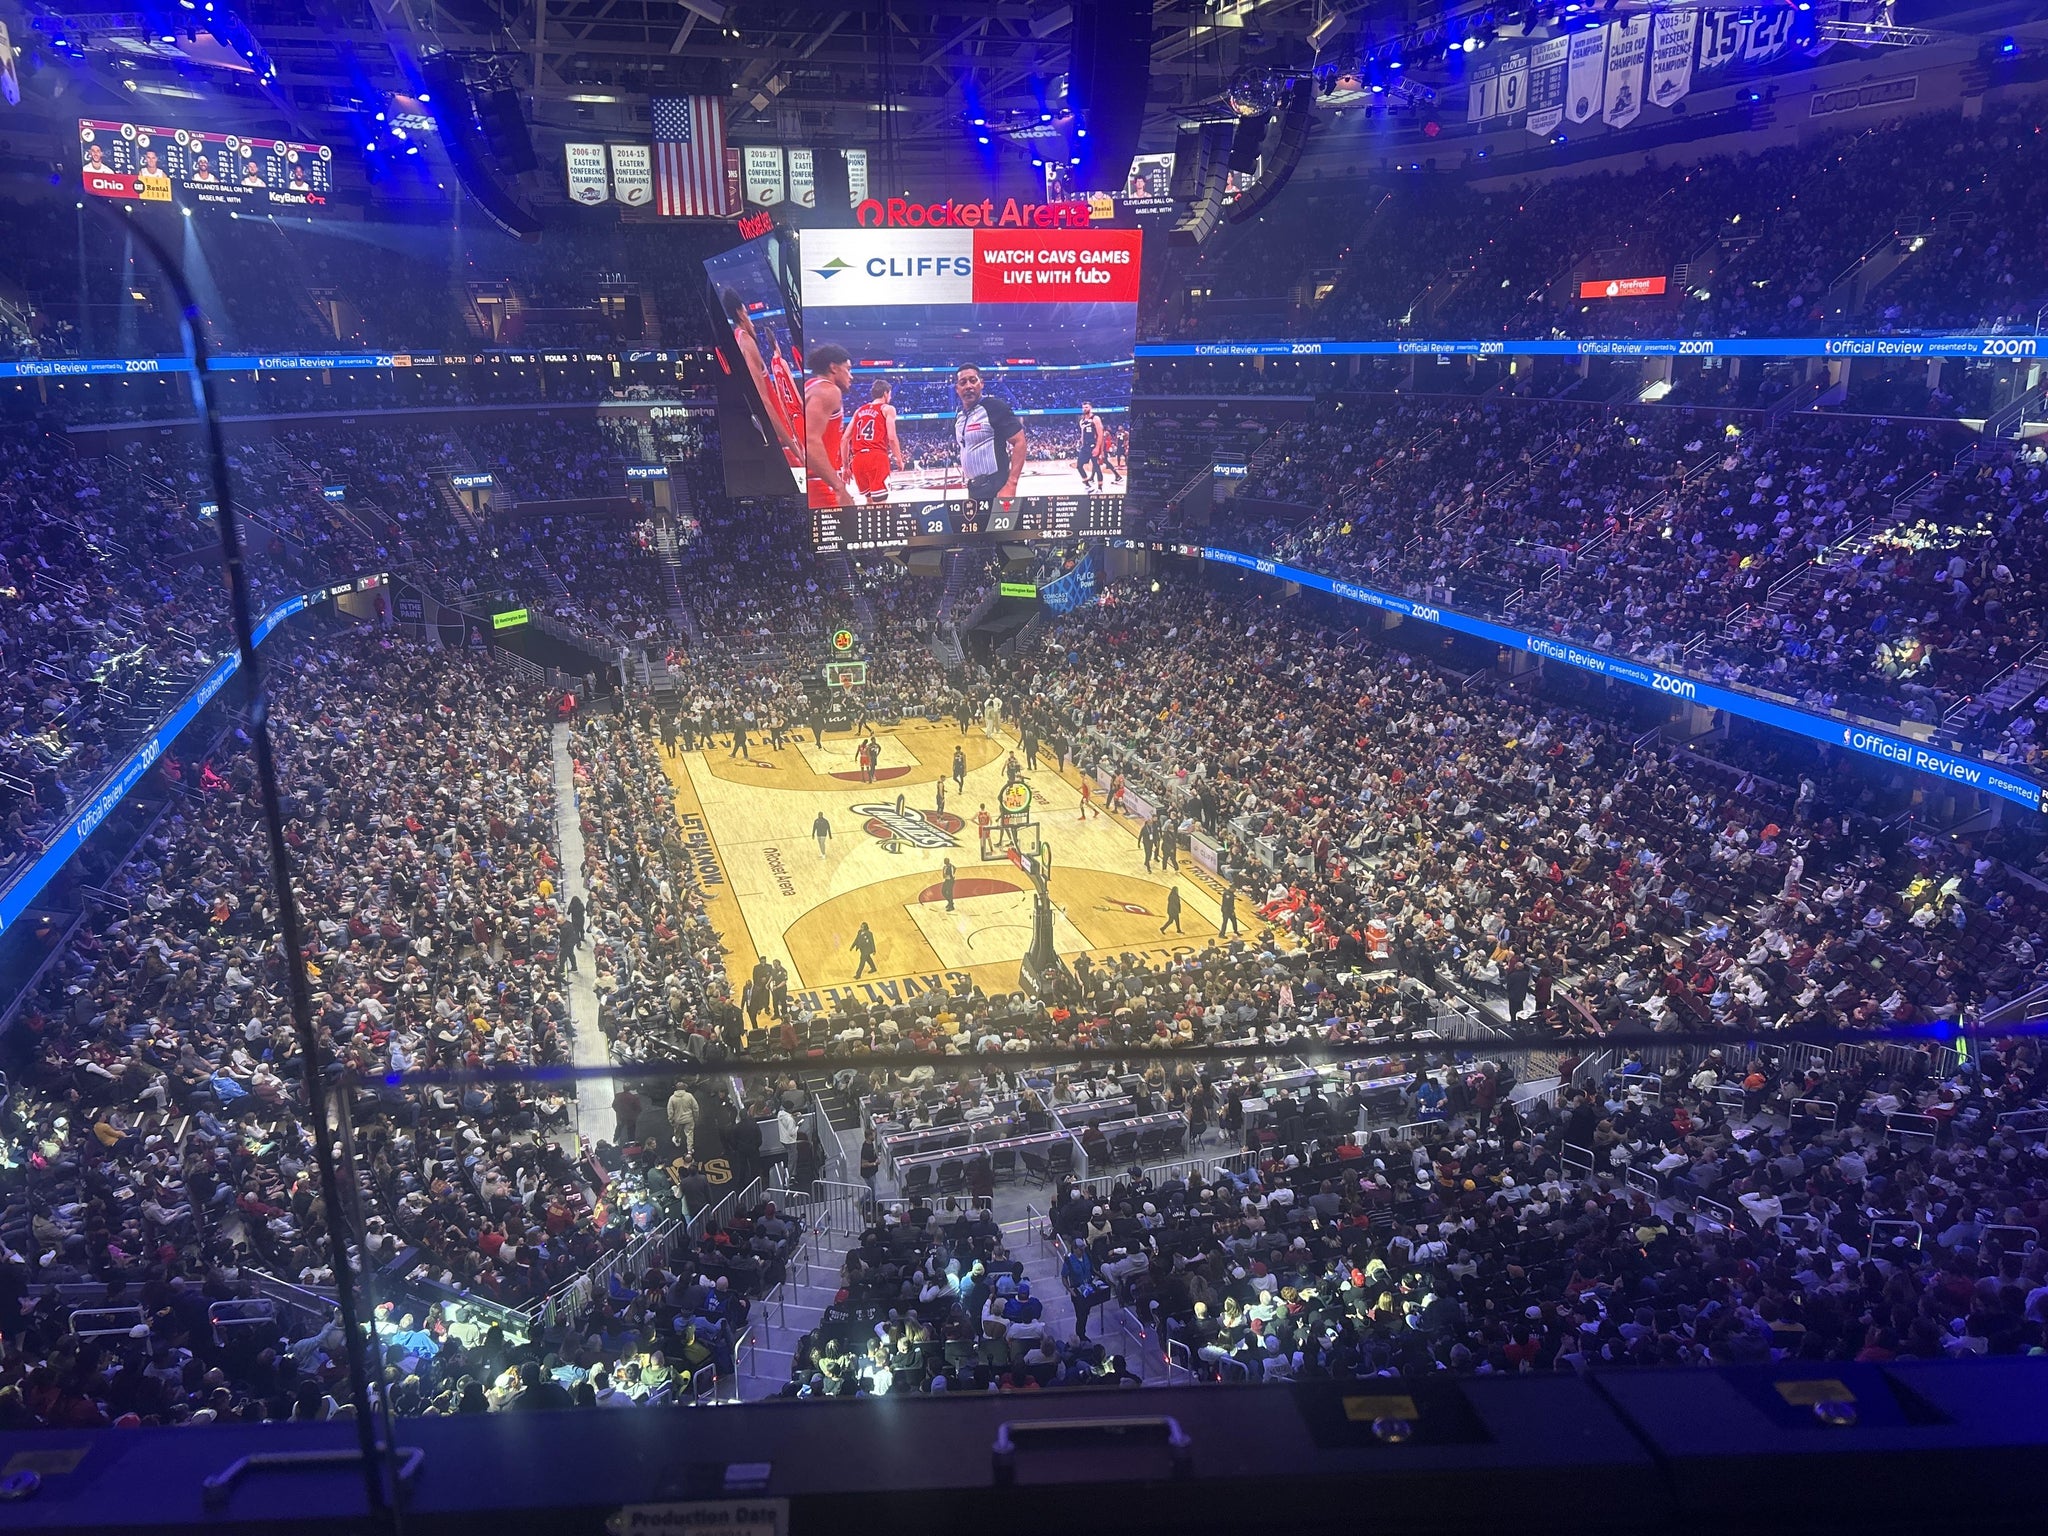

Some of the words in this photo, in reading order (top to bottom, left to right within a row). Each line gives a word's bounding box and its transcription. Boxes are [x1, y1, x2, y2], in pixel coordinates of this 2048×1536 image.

[1660, 13, 1691, 29] 2015-16
[1621, 24, 1638, 38] 2016
[1660, 29, 1689, 45] WESTERN
[1533, 39, 1567, 56] CLEVELAND
[1572, 42, 1603, 60] CHAMPIONS
[1611, 41, 1633, 58] CALDER
[1634, 37, 1645, 50] CUP
[1653, 42, 1693, 60] CONFERENCE
[1537, 50, 1561, 63] BARONS
[1610, 52, 1644, 71] CHAMPIONS
[1501, 57, 1527, 72] GLOVER
[1654, 57, 1688, 74] CHAMPIONS
[1507, 75, 1517, 108] 9
[1479, 84, 1486, 116] 1
[572, 148, 600, 156] 2006-07
[751, 150, 777, 158] 2016-17
[574, 159, 601, 167] EASTERN
[619, 160, 645, 168] EASTERN
[570, 167, 607, 175] CONFERENCE
[615, 168, 650, 176] CONFERENCE
[748, 169, 782, 177] CONFERENCE
[93, 179, 124, 191] Ohio
[572, 176, 606, 184] CHAMPIONS
[146, 185, 169, 193] Rental
[183, 182, 219, 192] CLEVELAND'S
[269, 192, 307, 204] KeyBank
[888, 198, 993, 227] Rocket
[999, 198, 1090, 227] Arena
[984, 250, 1035, 264] WATCH
[1038, 250, 1077, 264] CAVS
[1080, 250, 1130, 263] GAMES
[867, 257, 971, 278] CLIFFS
[1003, 270, 1033, 284] LIVE
[1036, 270, 1072, 284] WITH
[1074, 267, 1111, 284] fubo
[1620, 279, 1650, 289] ForeFront
[1201, 346, 1229, 354] Official
[1231, 345, 1258, 354] Review
[1292, 344, 1321, 353] zoom
[1403, 343, 1430, 352] Official
[1431, 343, 1455, 352] Review
[1480, 342, 1503, 352] zoom
[1582, 342, 1610, 353] Official
[1612, 343, 1641, 353] Review
[1669, 344, 1676, 352] by
[1679, 341, 1713, 354] zoom
[1832, 341, 1875, 354] Official
[1878, 341, 1923, 354] Review
[1929, 342, 1966, 352] presented
[1967, 342, 1978, 352] by
[1982, 340, 2036, 355] zoom
[265, 357, 298, 368] Official
[300, 357, 334, 367] Review
[657, 353, 668, 361] 28
[21, 363, 51, 374] Official
[54, 362, 87, 373] Review
[91, 363, 114, 371] presented
[125, 360, 158, 372] zoom
[856, 419, 875, 440] 14
[628, 467, 647, 477] drug
[648, 466, 667, 475] mart
[1214, 465, 1230, 475] drug
[1231, 465, 1248, 474] mart
[454, 476, 473, 486] drug
[474, 475, 492, 484] mart
[979, 501, 989, 510] 24
[927, 521, 943, 533] 28
[961, 523, 978, 533] 2:16
[994, 518, 1009, 529] 20
[1125, 540, 1135, 548] 28
[1180, 546, 1188, 554] 20
[1215, 550, 1237, 563] Review
[1256, 559, 1275, 574] zoom
[331, 584, 351, 595] BLOCKS
[400, 603, 407, 611] IN
[407, 603, 422, 611] THE
[1336, 583, 1358, 599] Official
[1359, 591, 1383, 605] Review
[1412, 604, 1439, 622] zoom
[1533, 639, 1566, 663] Official
[1568, 650, 1605, 670] Review
[1609, 664, 1640, 679] presented
[1640, 671, 1649, 682] by
[1652, 672, 1696, 698] zoom
[1853, 733, 1912, 763] Official
[1916, 751, 1981, 783] Review
[1988, 776, 2032, 799] presented
[81, 799, 103, 835] Official
[102, 782, 124, 811] Review
[141, 739, 159, 769] zoom
[681, 813, 705, 830] LET
[763, 853, 789, 876] Rocket
[775, 876, 796, 897] Arena
